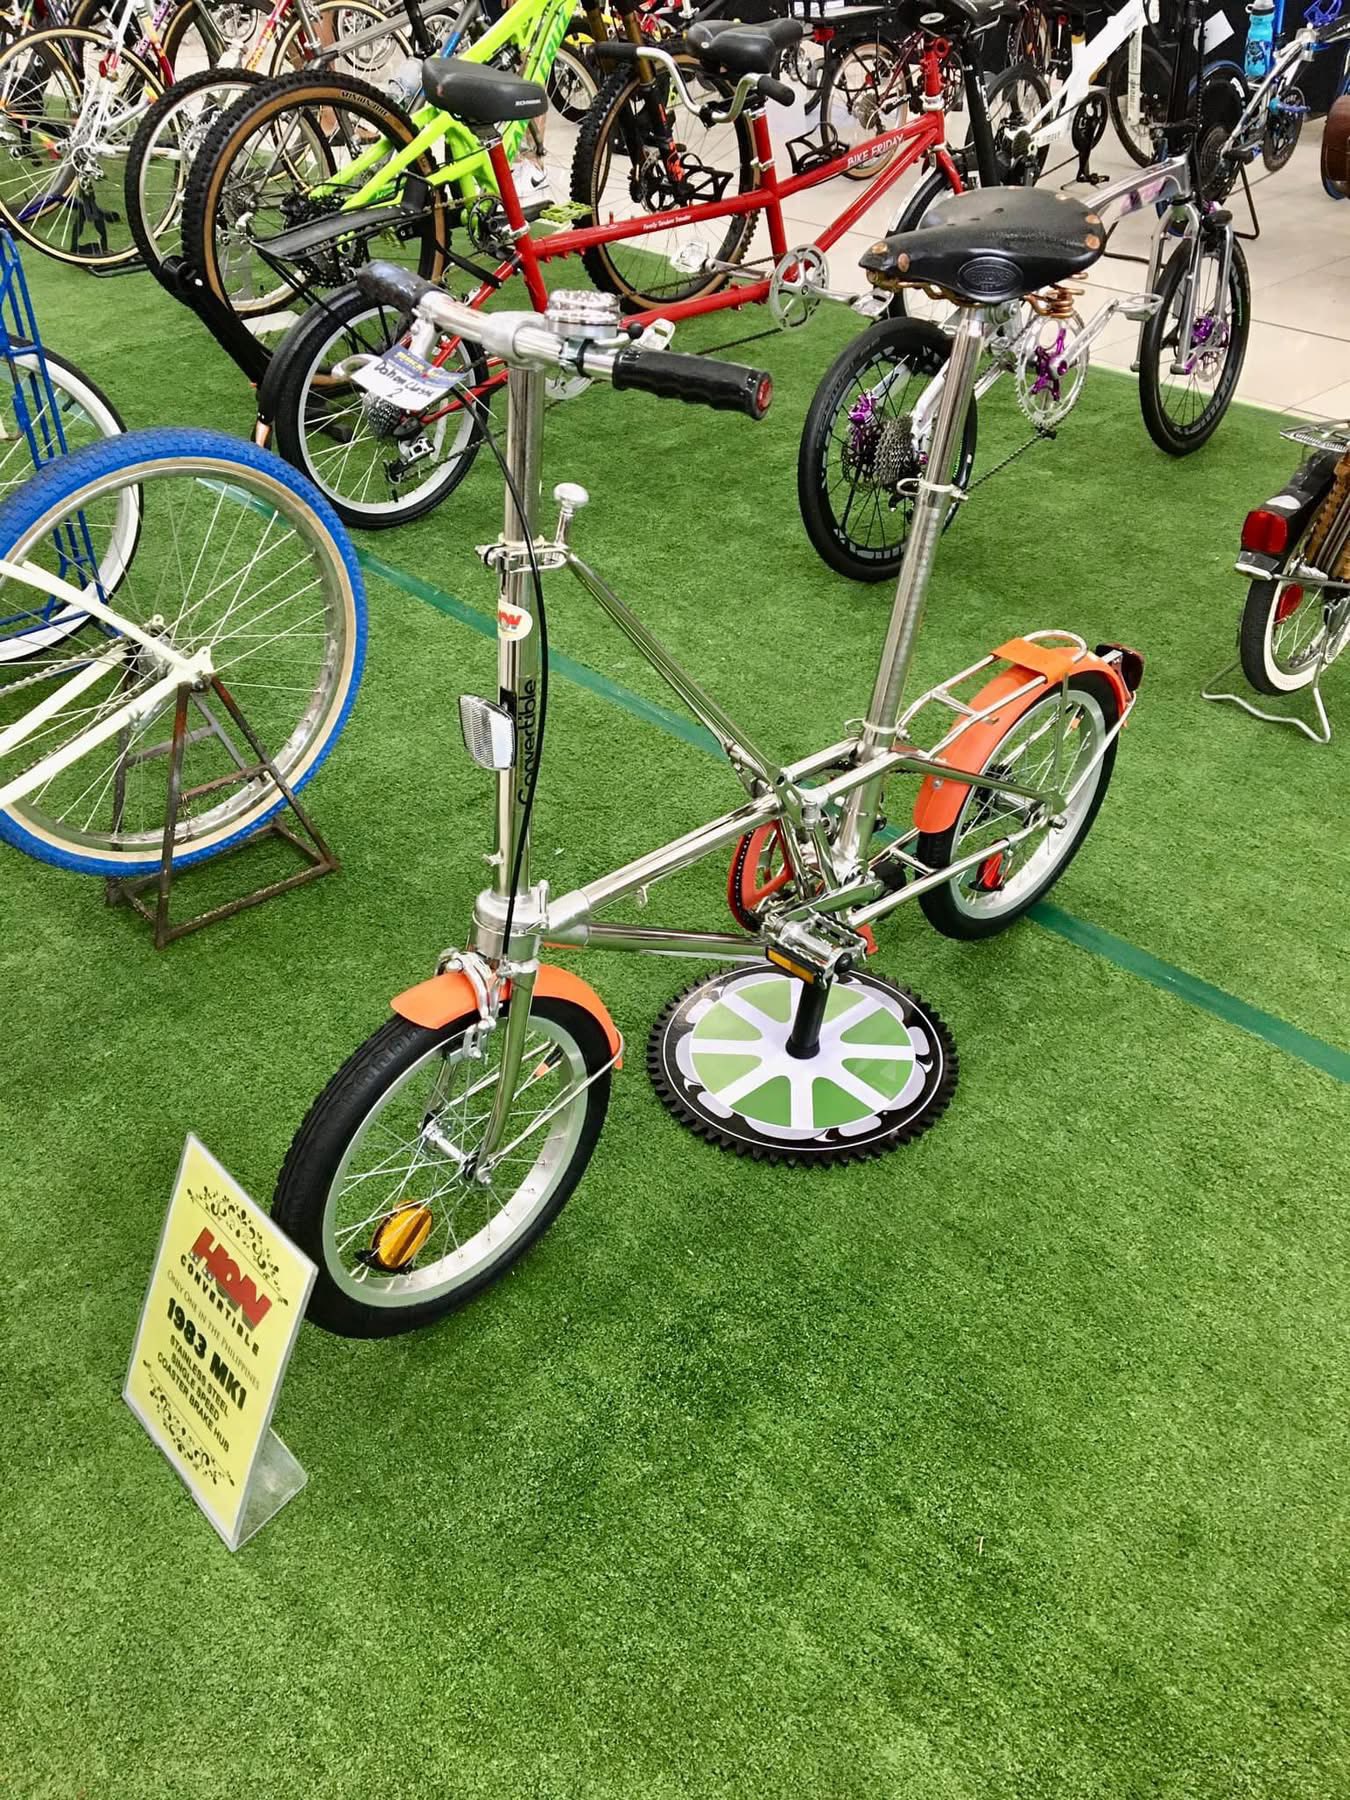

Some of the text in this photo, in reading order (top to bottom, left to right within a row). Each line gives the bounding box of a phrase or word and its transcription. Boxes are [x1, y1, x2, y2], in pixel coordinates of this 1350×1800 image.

[847, 133, 904, 168] BIKE FRIDAY
[180, 1254, 260, 1357] CONVERTIBLE
[188, 1226, 273, 1331] HON
[158, 1352, 230, 1453] COASTER BRAKE HUB
[167, 1297, 247, 1411] 1983 MK1
[170, 1334, 229, 1418] STAINLESS STEEL
[171, 1352, 220, 1421] SINGLE SPEED
